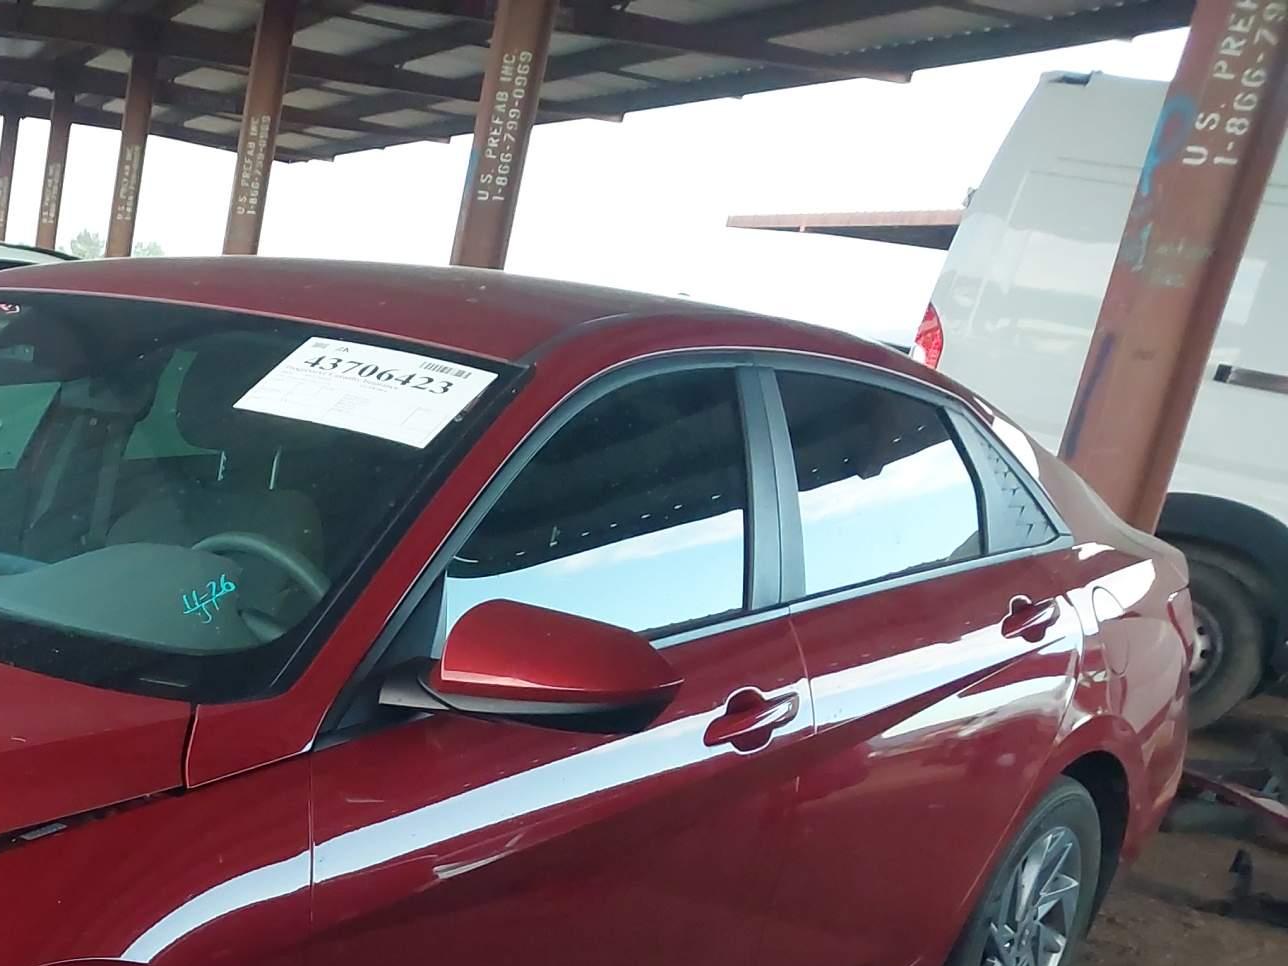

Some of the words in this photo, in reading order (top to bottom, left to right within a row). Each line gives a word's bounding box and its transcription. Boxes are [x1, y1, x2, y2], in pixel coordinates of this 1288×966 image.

[485, 90, 509, 159] PREFAB
[492, 51, 533, 201] 1-866-799-0969
[303, 354, 454, 395] 43706423
